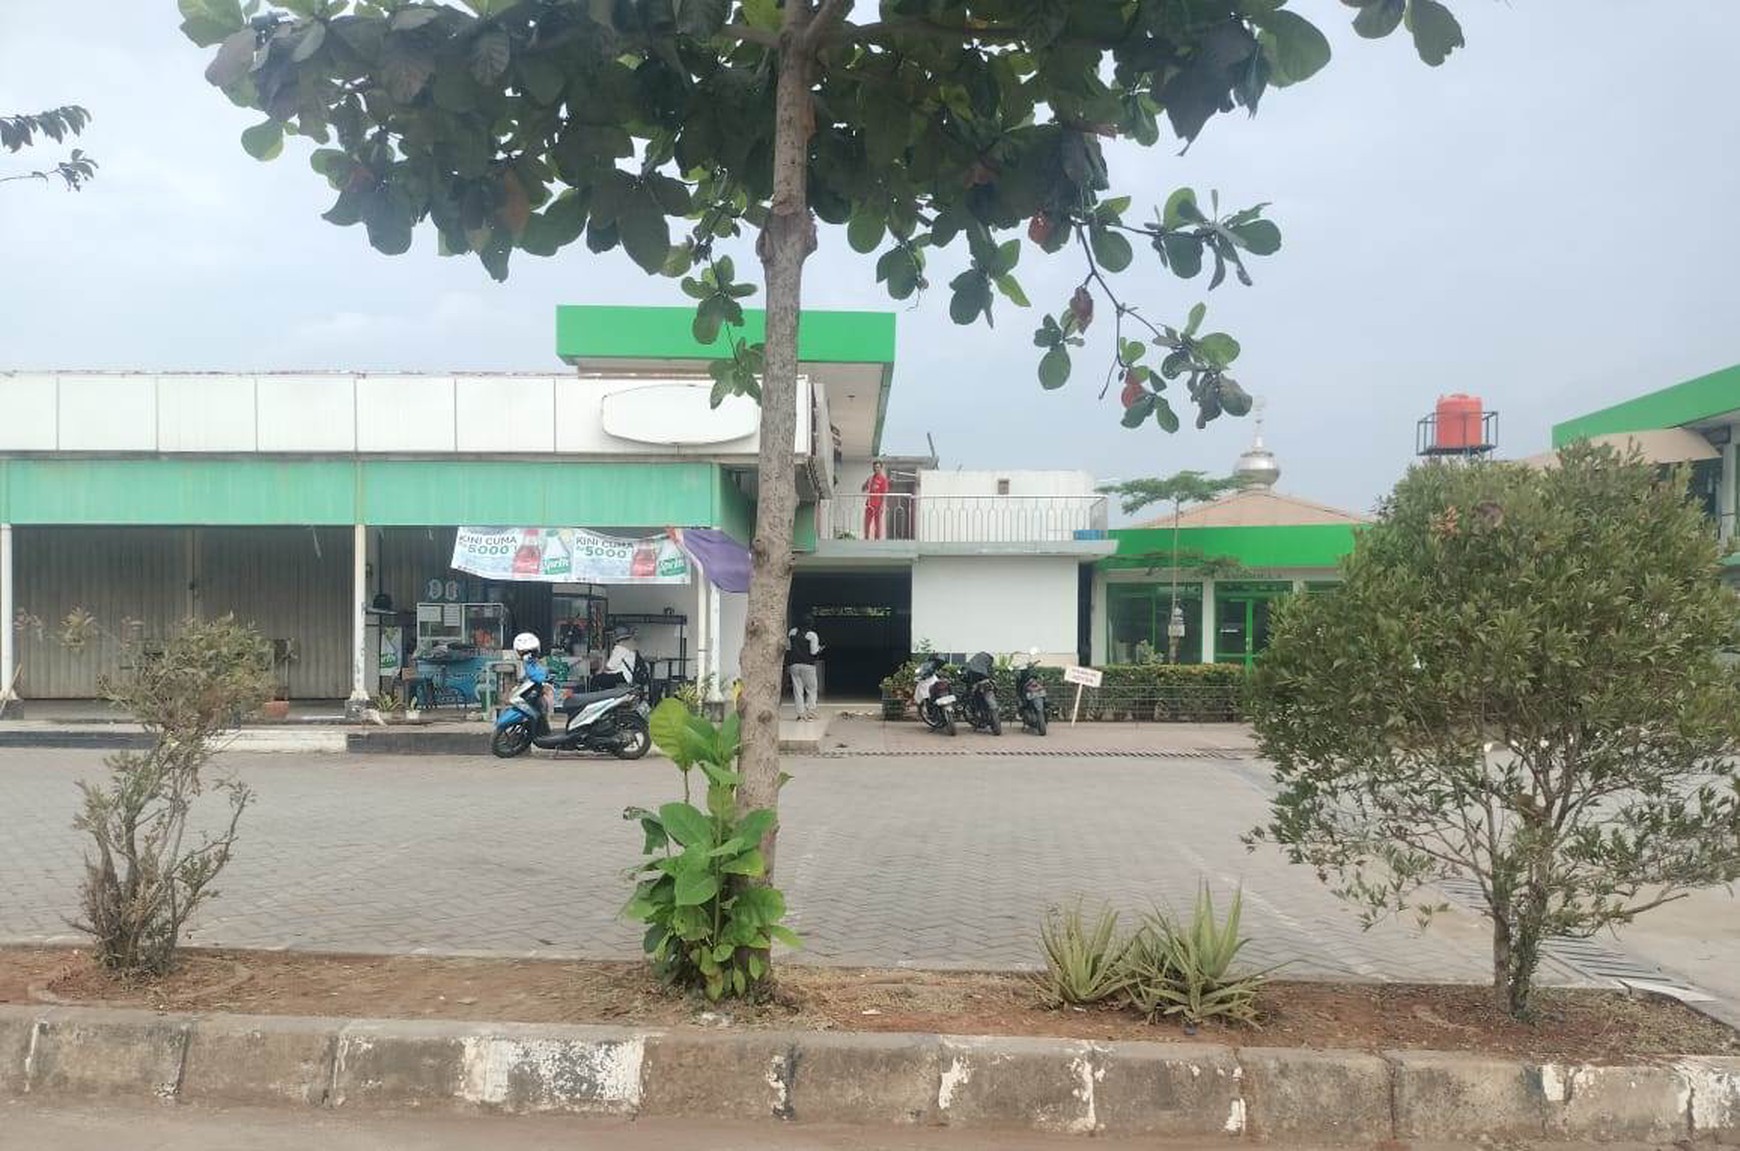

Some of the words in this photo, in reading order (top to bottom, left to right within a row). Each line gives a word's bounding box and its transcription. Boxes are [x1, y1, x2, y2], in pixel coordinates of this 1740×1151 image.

[459, 535, 482, 545] KINI
[485, 536, 517, 546] CUMA
[576, 536, 598, 546] KINI
